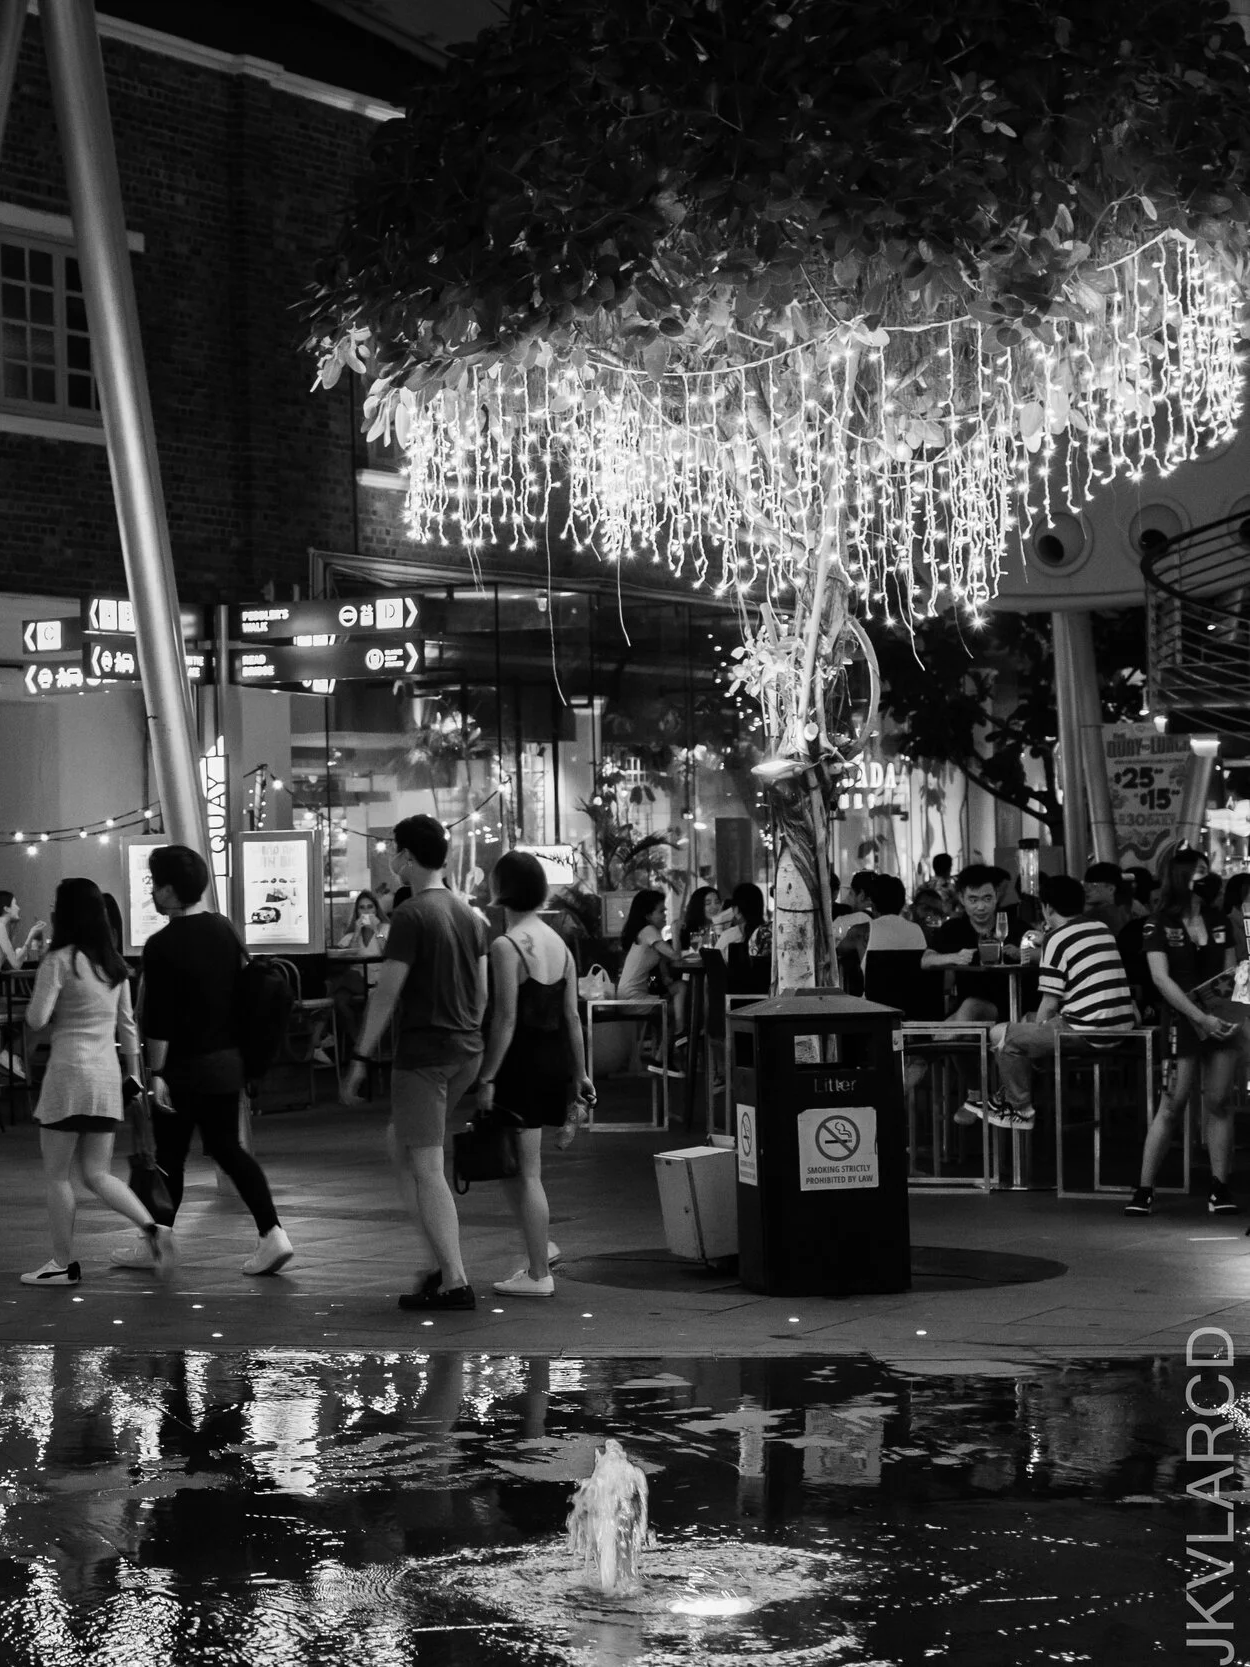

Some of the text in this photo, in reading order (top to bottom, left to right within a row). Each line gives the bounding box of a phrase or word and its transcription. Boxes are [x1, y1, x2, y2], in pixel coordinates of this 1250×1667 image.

[242, 621, 268, 633] WALK
[207, 777, 226, 854] QUAY
[814, 1078, 857, 1093] Litter
[807, 1164, 871, 1175] SMOKING STRICTLY
[805, 1174, 874, 1185] PROHIBITED BY LAW
